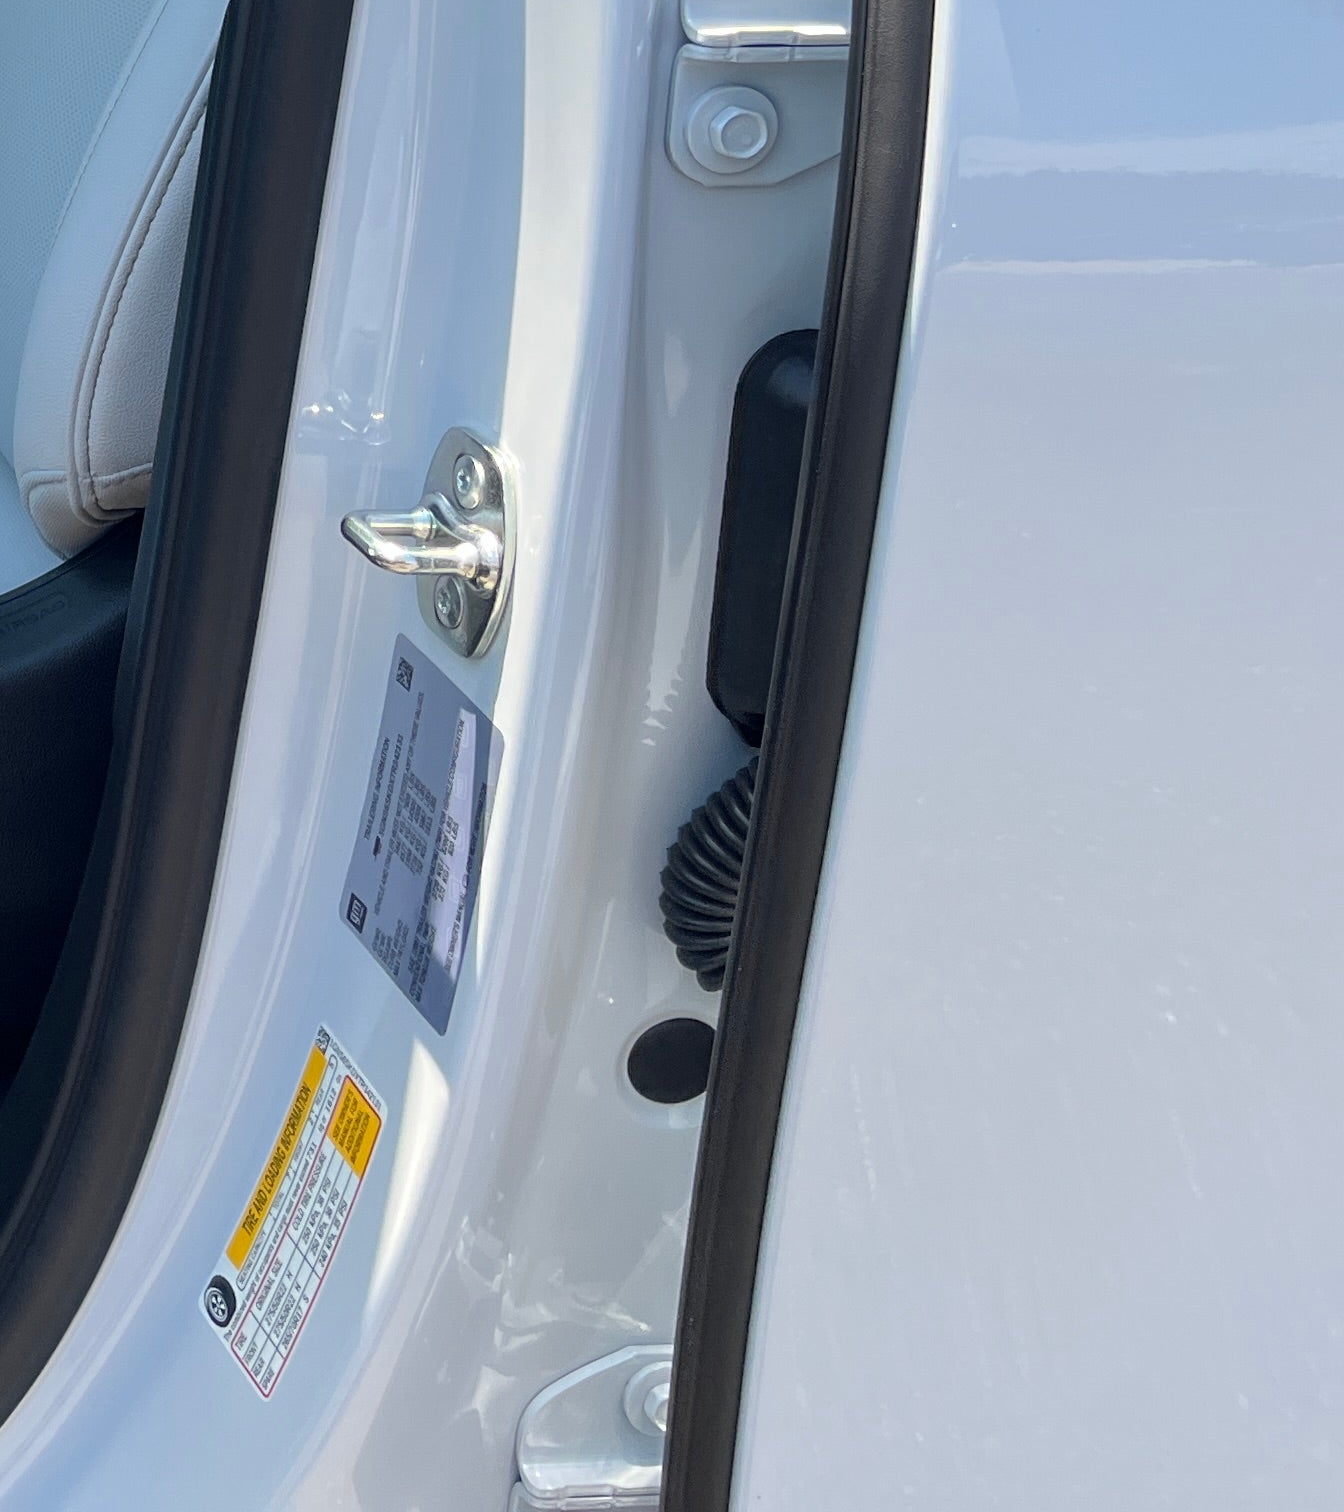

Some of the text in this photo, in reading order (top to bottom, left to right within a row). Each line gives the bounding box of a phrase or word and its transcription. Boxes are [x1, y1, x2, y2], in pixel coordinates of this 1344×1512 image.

[241, 1080, 313, 1238] TIRE AND LOADING INFORMATION
[290, 1205, 304, 1232] COLD
[306, 1150, 327, 1193] PRESSURE
[254, 1271, 275, 1314] ORIGINAL
